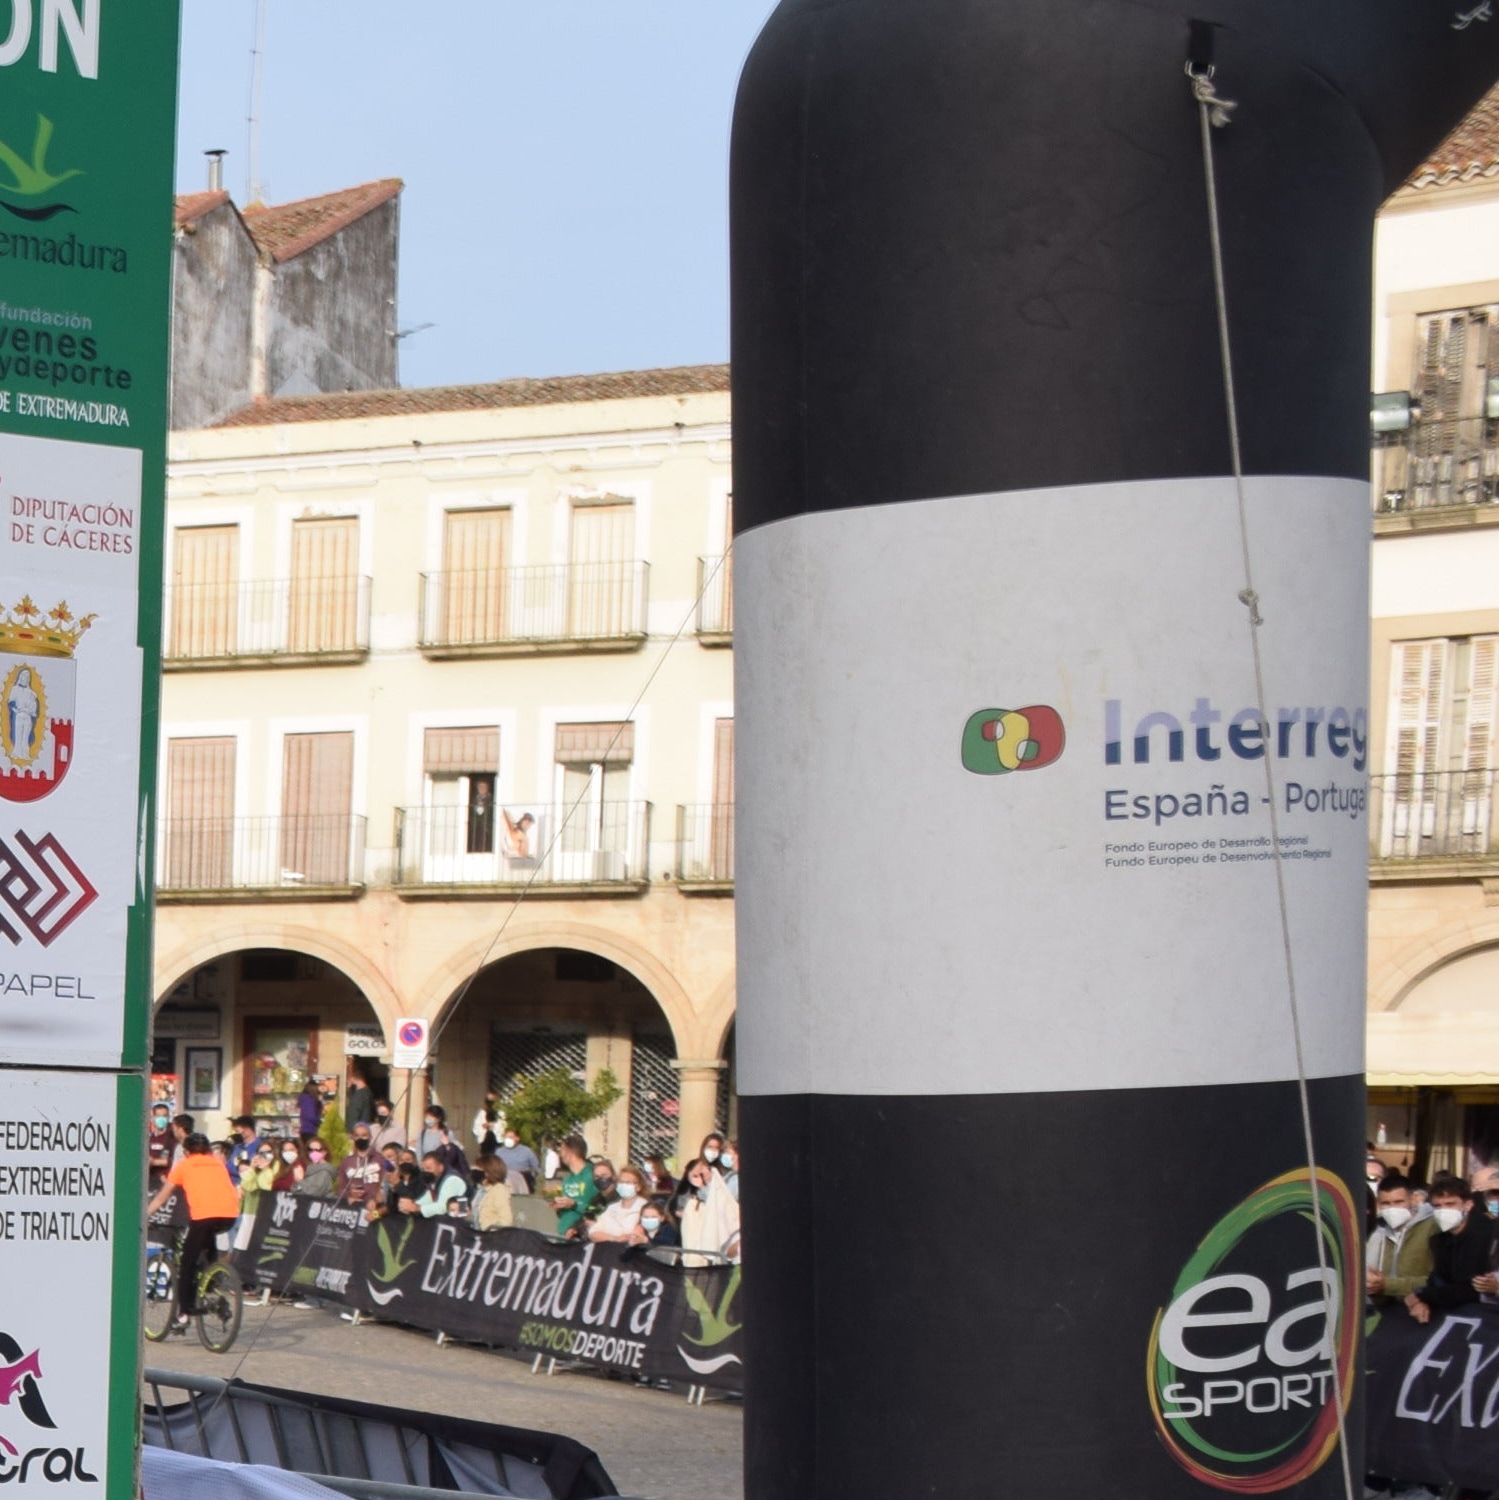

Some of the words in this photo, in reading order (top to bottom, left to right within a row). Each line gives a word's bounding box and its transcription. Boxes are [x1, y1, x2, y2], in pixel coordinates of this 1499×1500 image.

[16, 392, 130, 427] EXTREMADURA
[12, 495, 134, 529] DIPUTACIÓN
[11, 523, 35, 545] DE
[43, 523, 134, 555] CÁCERES
[1104, 697, 1368, 772] Interreg
[1105, 784, 1250, 826] España
[1105, 844, 1145, 854] Fondo
[1148, 841, 1198, 853] Europeo
[1202, 839, 1216, 849] de
[1105, 858, 1145, 868] Fundo
[1202, 853, 1217, 863] de
[421, 1223, 665, 1337] Extremadura
[1158, 1265, 1341, 1373] ea
[1162, 1369, 1337, 1419] SPORT
